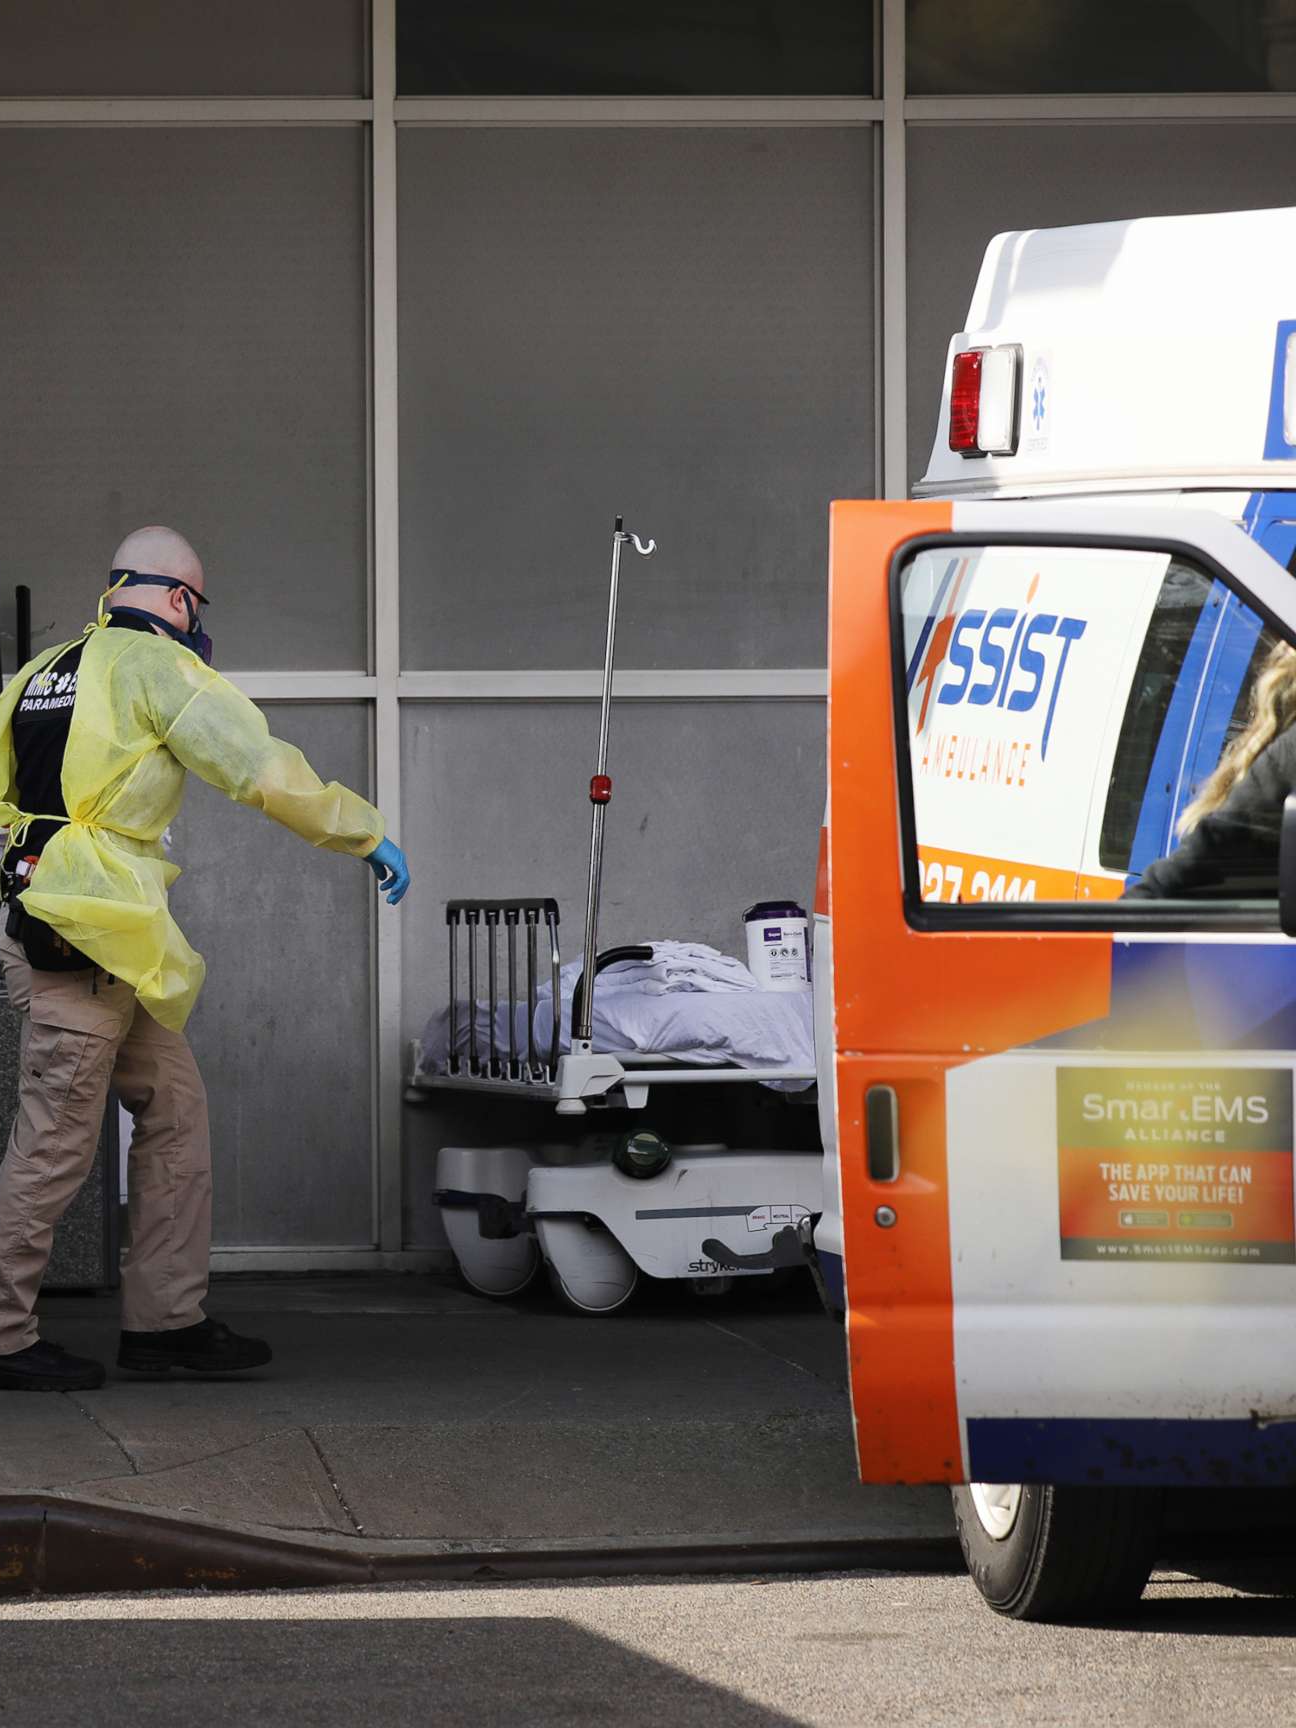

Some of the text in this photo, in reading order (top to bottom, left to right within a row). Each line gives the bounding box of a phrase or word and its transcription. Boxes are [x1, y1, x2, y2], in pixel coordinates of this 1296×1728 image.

[19, 694, 76, 712] PARAMEDI
[920, 735, 1032, 786] AMBULANCE
[1124, 1128, 1225, 1143] ALLIANCE
[1100, 1162, 1253, 1184] THE APP THAT CAN
[1109, 1184, 1244, 1204] SAVE YOUR LIFE!
